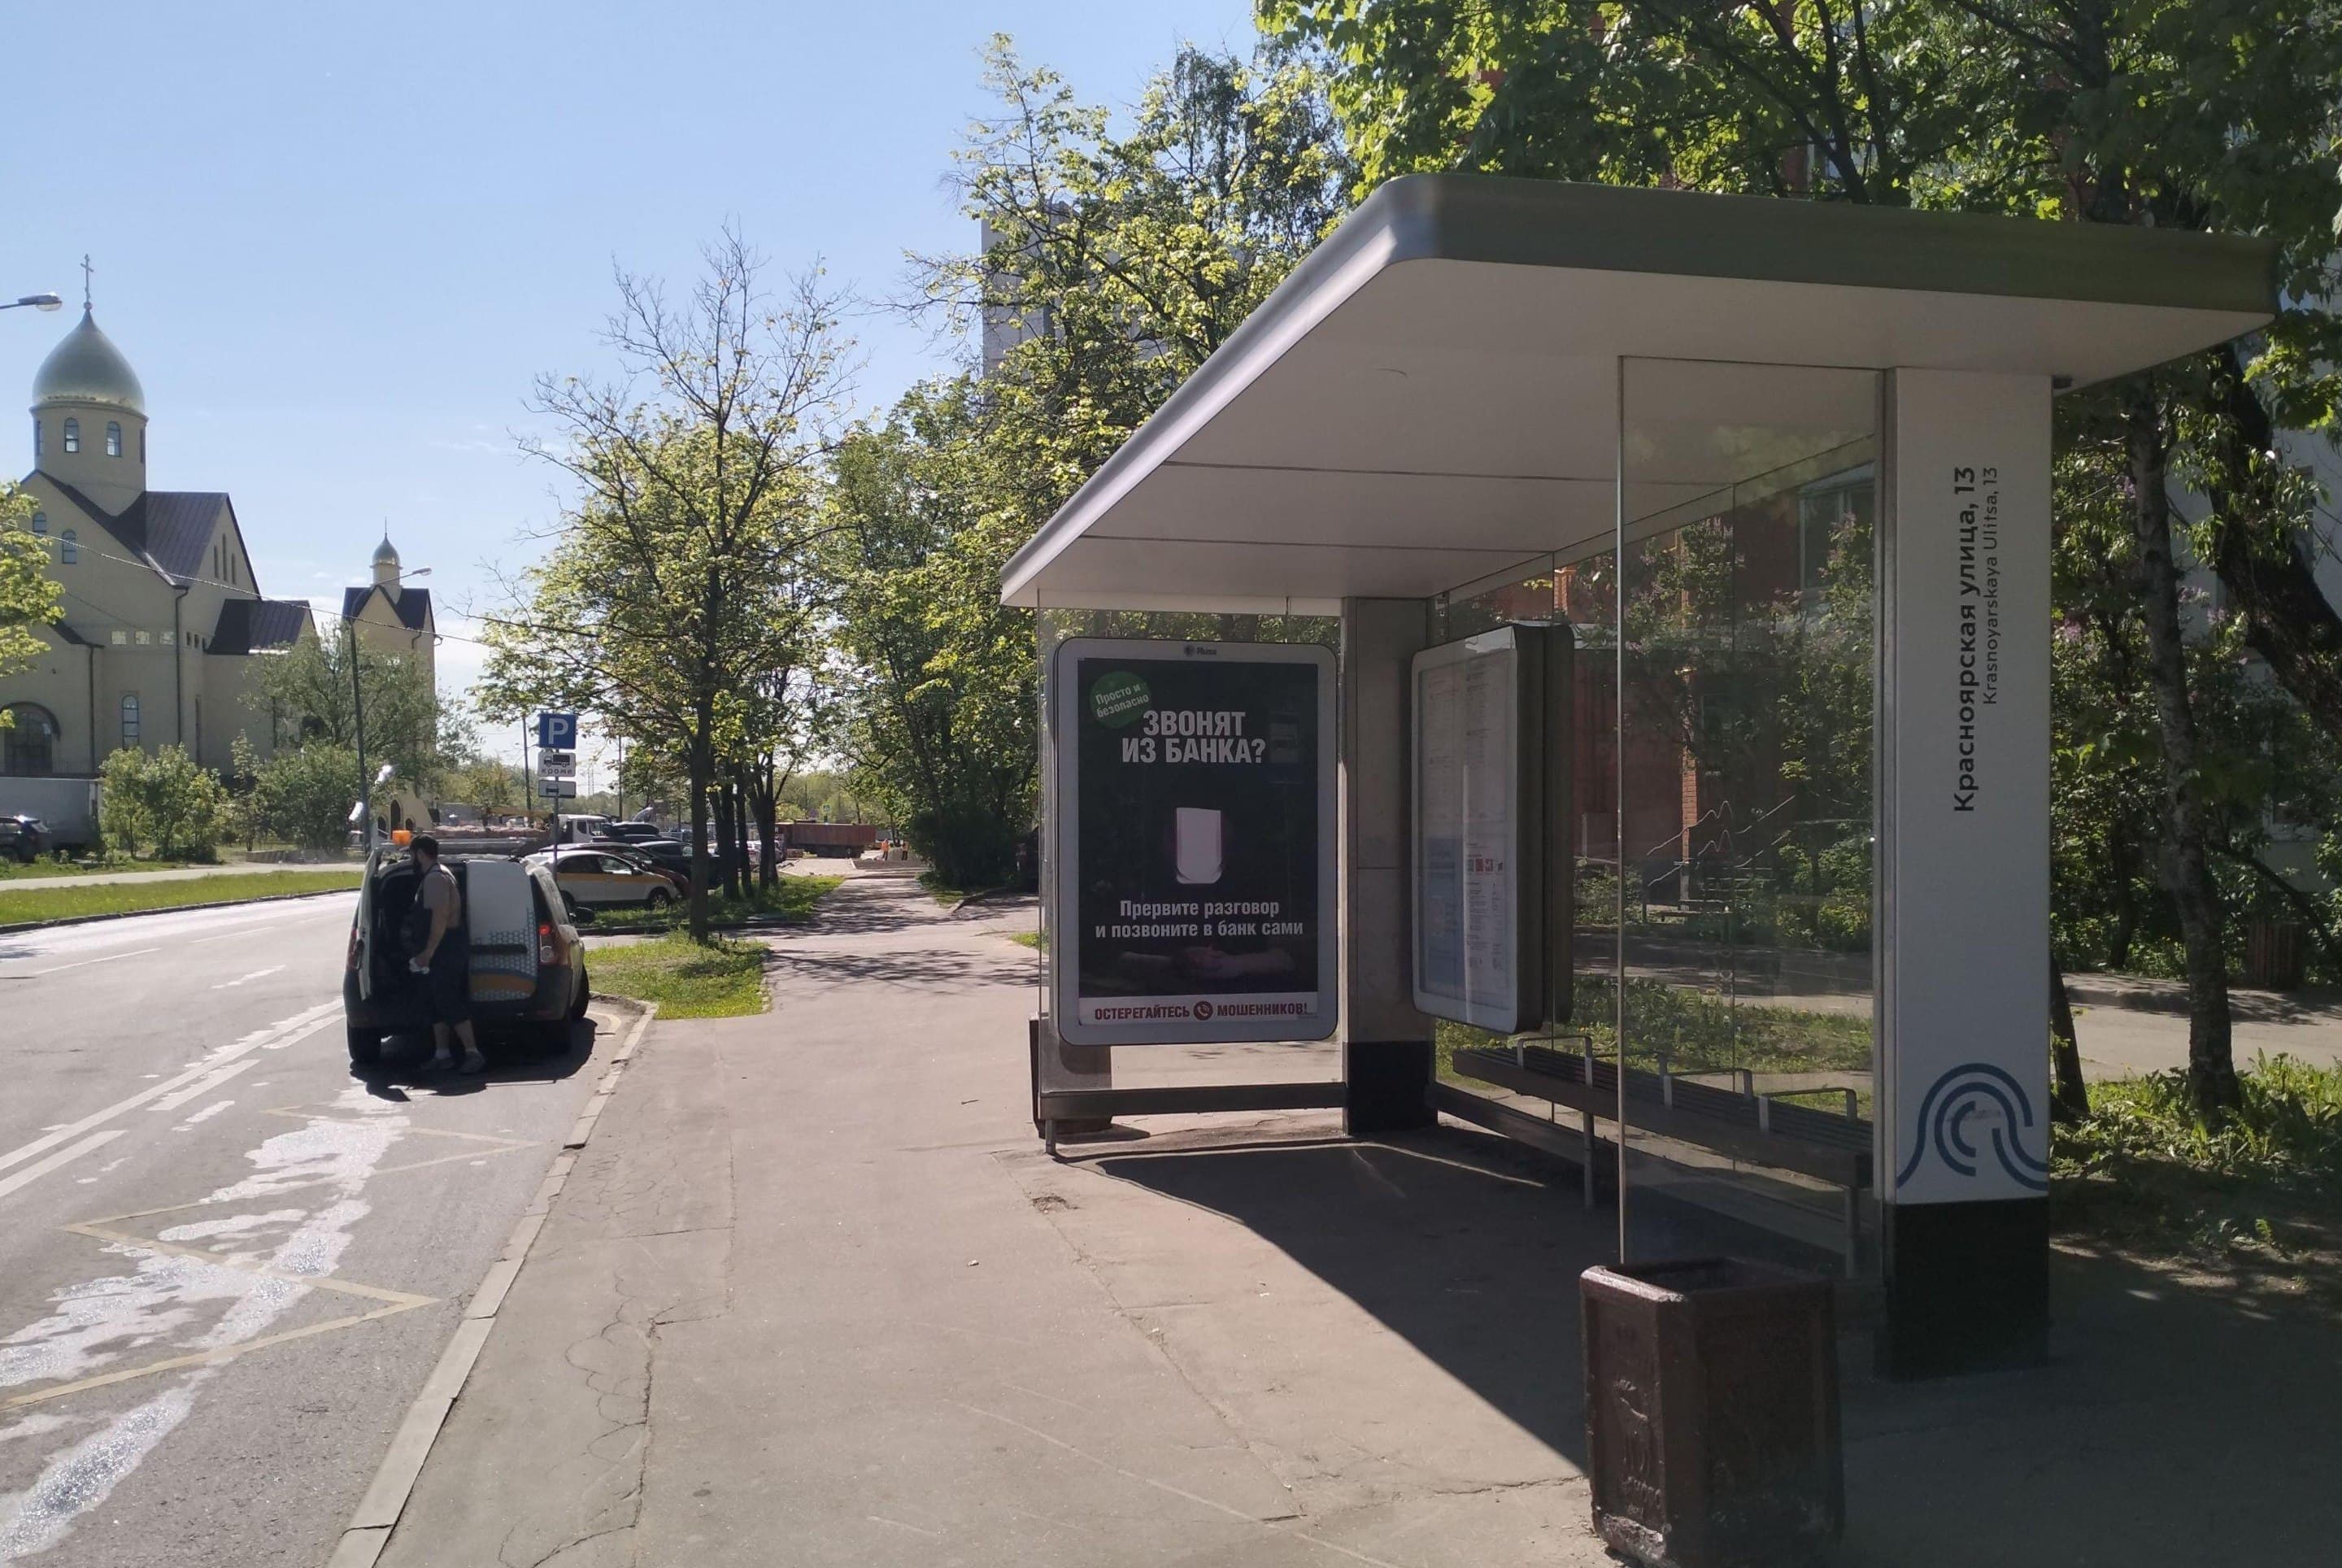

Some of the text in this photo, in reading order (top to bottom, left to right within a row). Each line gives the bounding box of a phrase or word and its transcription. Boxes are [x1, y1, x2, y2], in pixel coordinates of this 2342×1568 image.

[1983, 466, 2001, 704] Krasnoyarskaya Ulitsa, 13
[1954, 466, 1980, 812] Красноярская улица, 13
[1095, 686, 1132, 705] Просто
[1096, 693, 1150, 717] безопасно
[548, 717, 568, 744] P
[1143, 710, 1246, 736] ЗВОНЯТ
[1121, 738, 1266, 764] ИЗ БАНКА?
[1120, 900, 1279, 920] Прервите разговор
[1095, 920, 1304, 938] и позвоните в банк сами
[1095, 1002, 1308, 1020] ОСТЕРЕГАЙТЕСЬ МОШЕННИКОВ!
